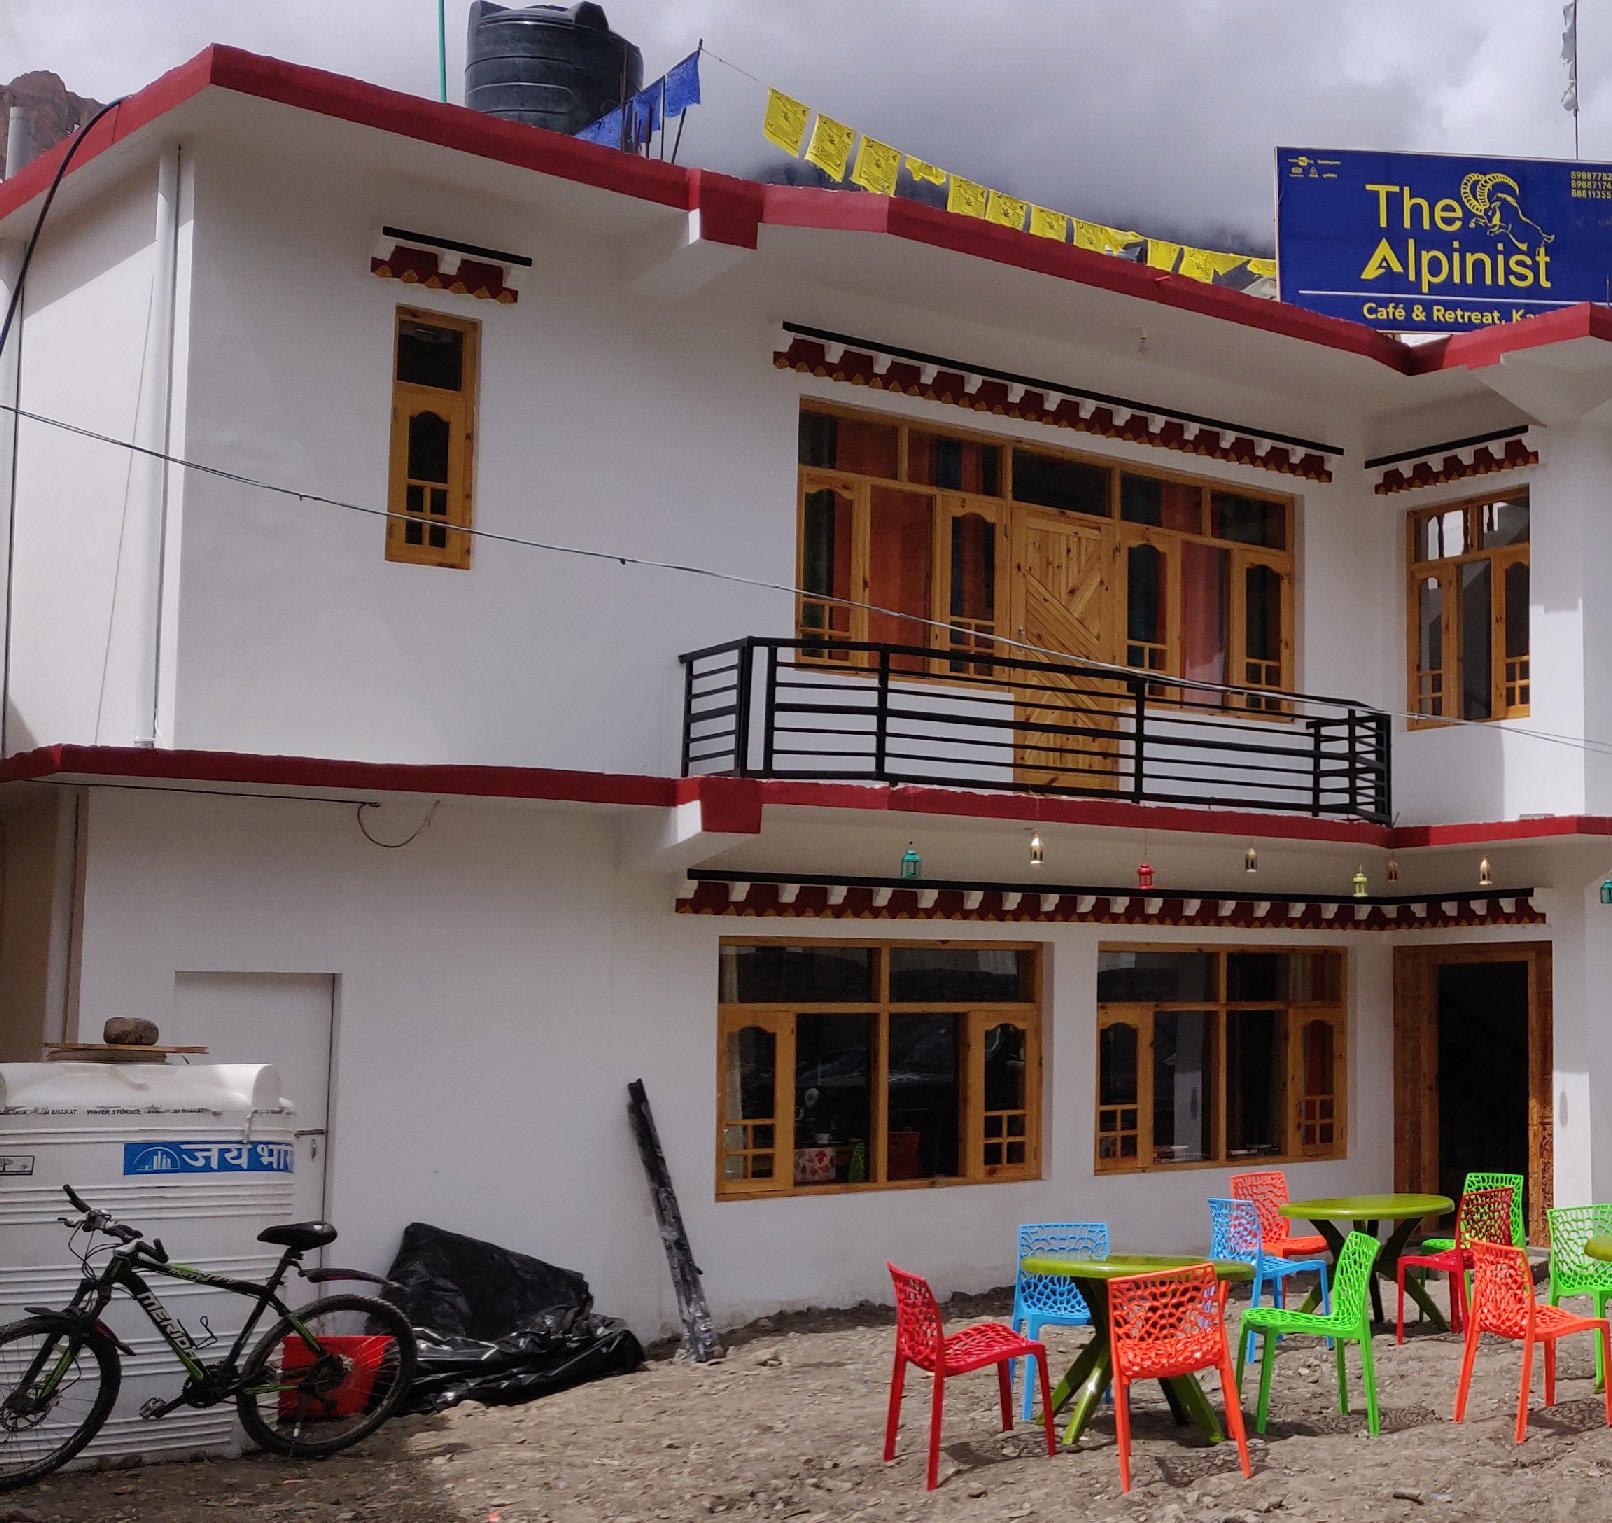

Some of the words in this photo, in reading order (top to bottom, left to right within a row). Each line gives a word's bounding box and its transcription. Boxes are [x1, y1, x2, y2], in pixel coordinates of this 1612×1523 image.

[1365, 184, 1463, 232] The
[1360, 237, 1552, 294] Alpinist
[1363, 302, 1406, 320] Café
[1412, 304, 1426, 321] &
[1432, 305, 1506, 326] Retreat,
[179, 1144, 252, 1169] जय
[137, 1291, 200, 1361] MERIDA
